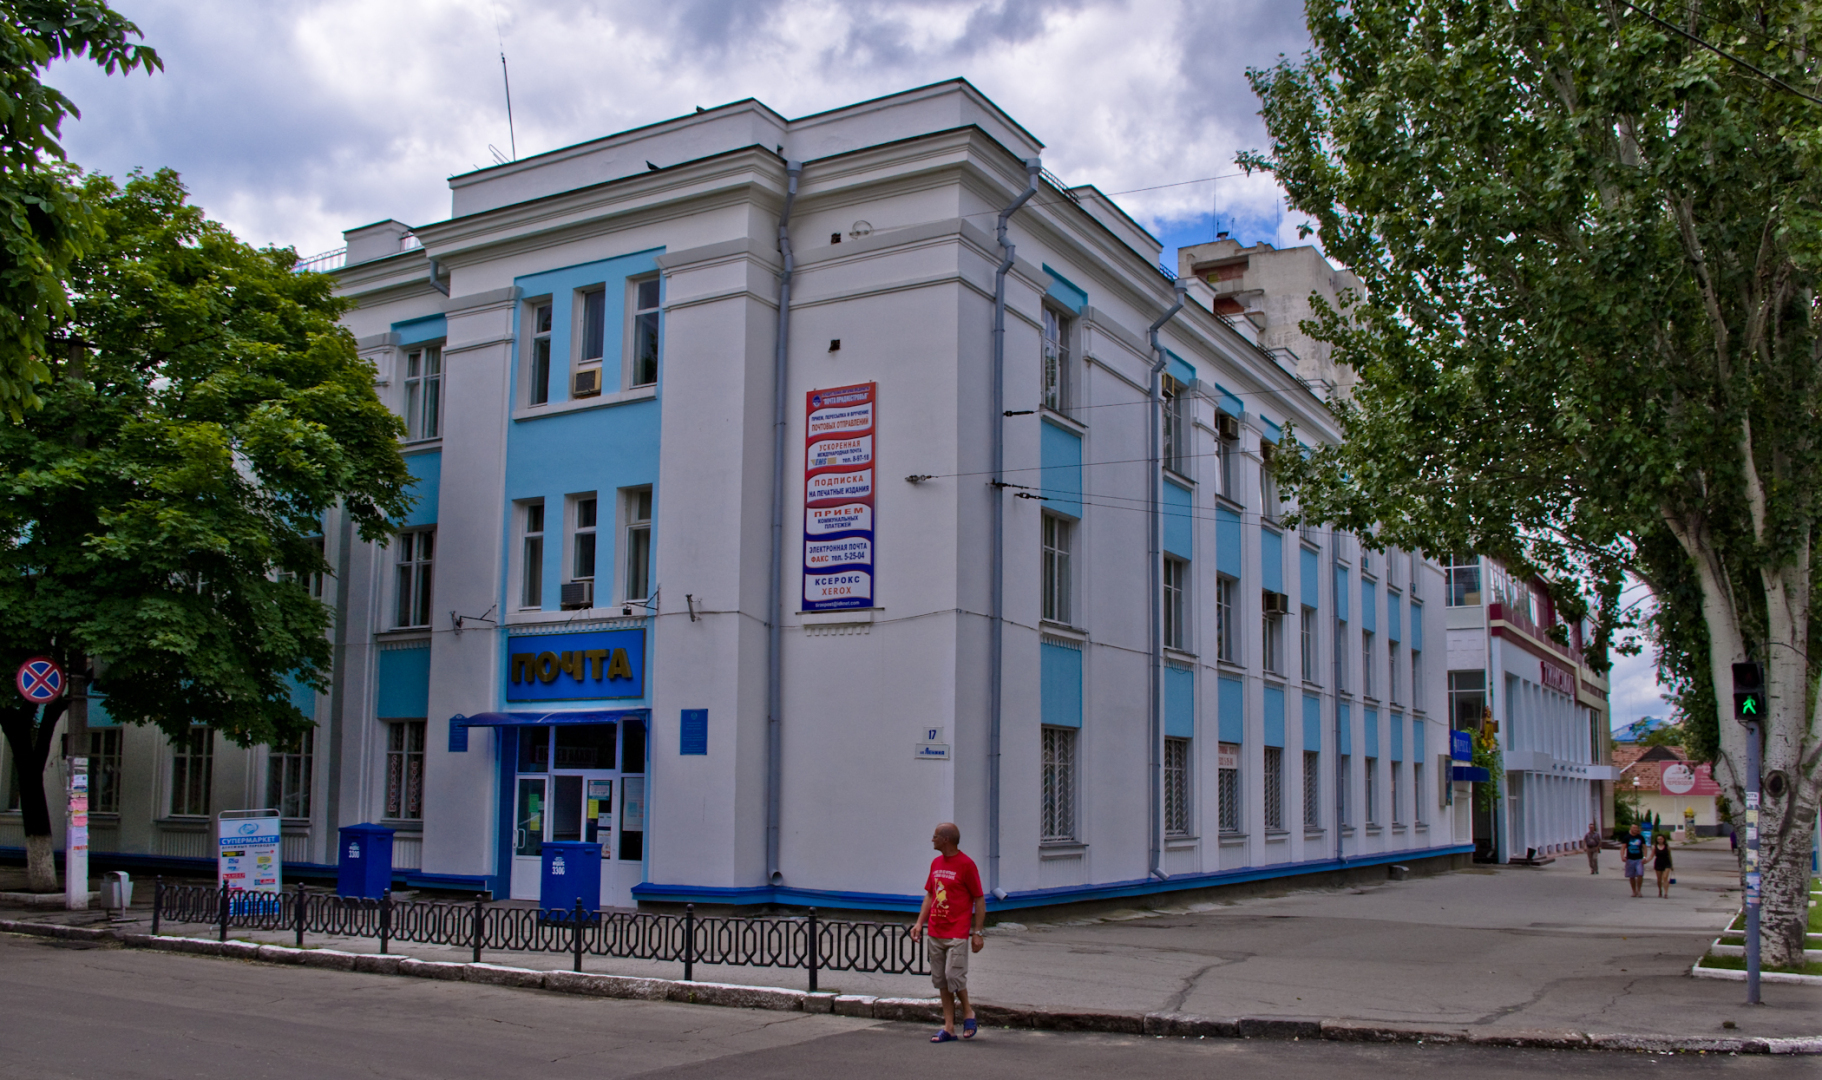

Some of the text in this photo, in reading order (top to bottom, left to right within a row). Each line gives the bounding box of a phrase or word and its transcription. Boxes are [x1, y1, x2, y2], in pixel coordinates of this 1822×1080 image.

[811, 416, 869, 432] ПОЧТОВЫХ ОТПРАВЛЕНИЙ
[819, 440, 861, 452] УСКОРЕННАЯ
[815, 475, 863, 486] ПОДПИСКА
[808, 485, 870, 498] НА ПЕЧАТНЫЕ ИЗДАНИЯ
[814, 508, 863, 517] ПРИЕМ
[817, 515, 859, 524] КОММУНАЛЬНЫХ
[809, 542, 868, 554] ЭЛЕКТРОННАЯ ПОЧТА
[810, 555, 829, 563] ФАКС
[844, 551, 865, 561] 5-25-04
[815, 576, 860, 585] КСЕРОКС
[821, 586, 852, 596] XEROX
[511, 648, 632, 684] ПОЧТА
[928, 729, 937, 740] 17
